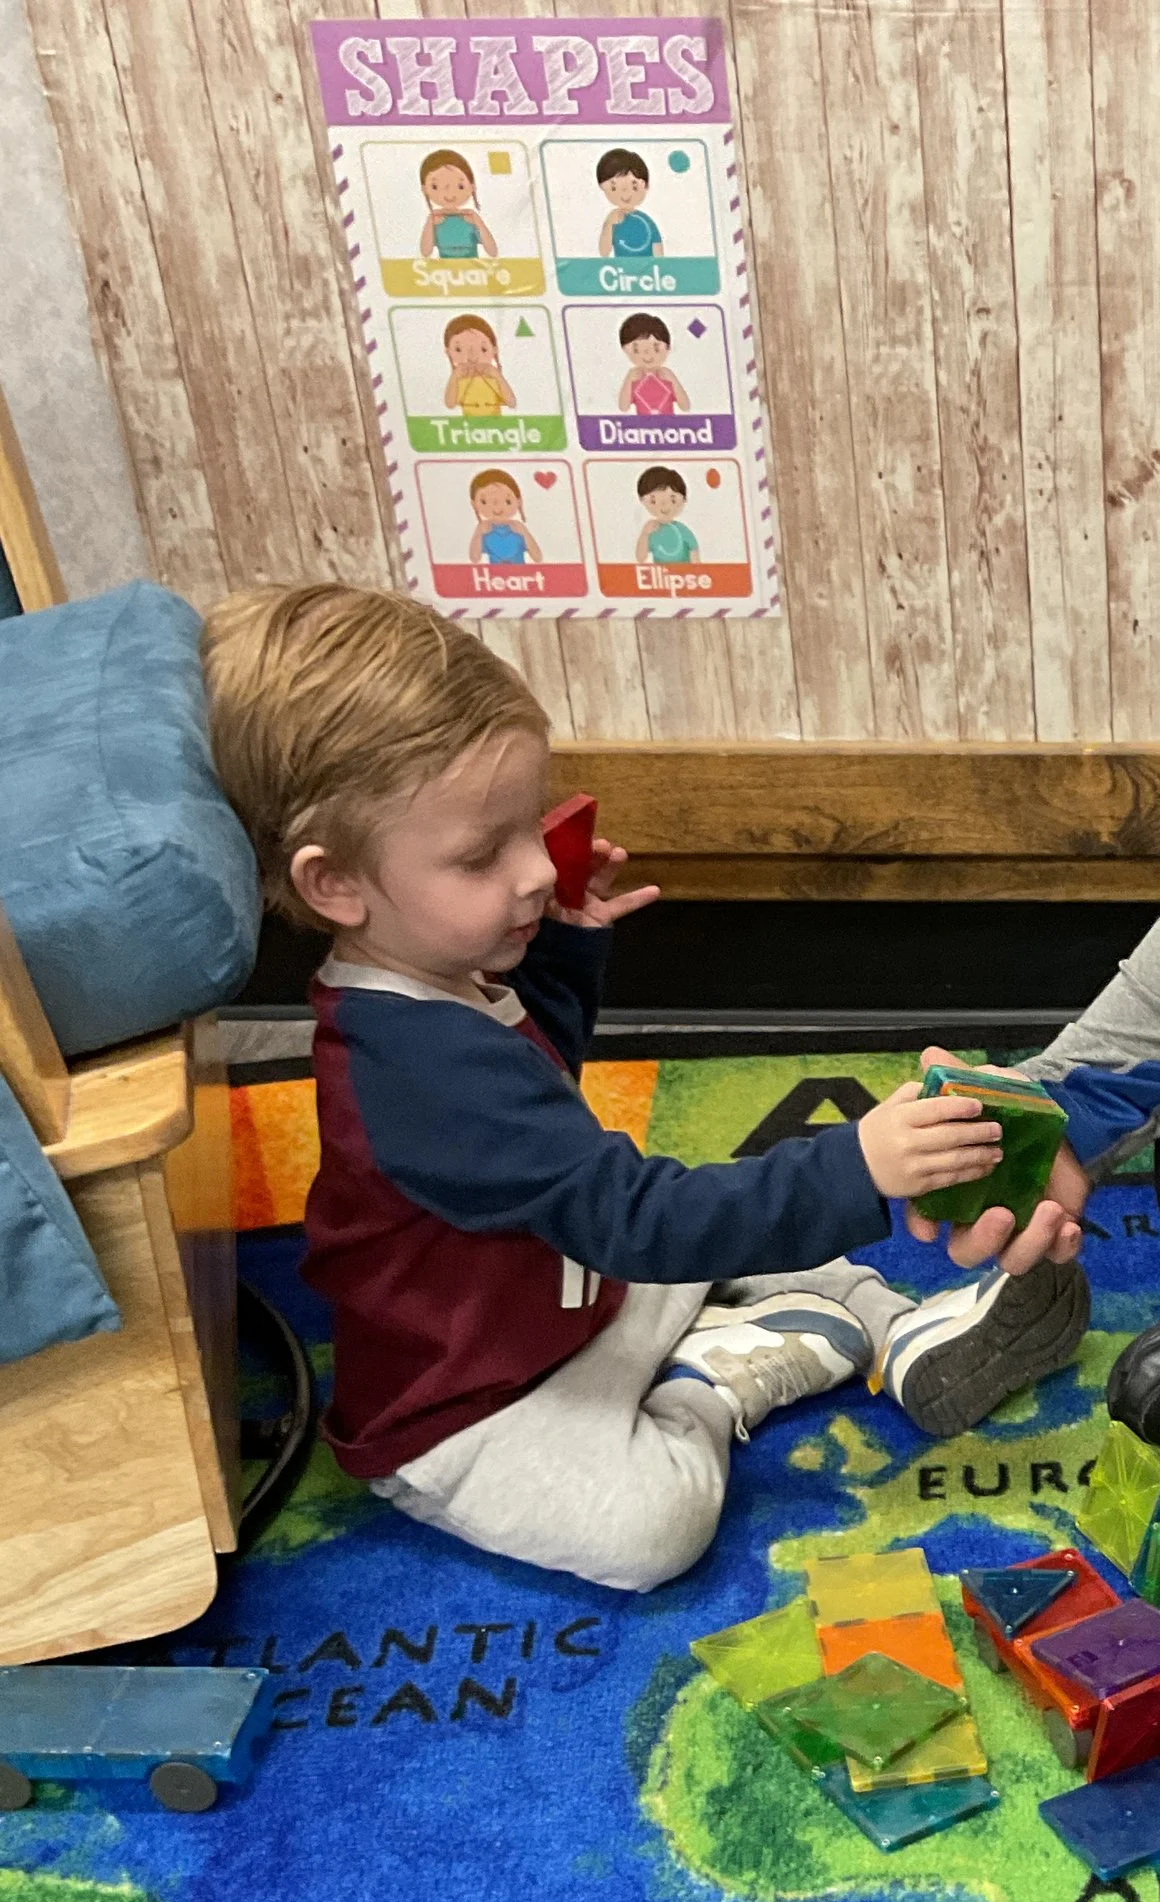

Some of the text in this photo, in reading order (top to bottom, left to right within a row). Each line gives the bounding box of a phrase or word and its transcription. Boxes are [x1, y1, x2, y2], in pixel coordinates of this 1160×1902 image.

[338, 34, 716, 117] SHAPES
[412, 262, 512, 289] Square
[599, 266, 677, 293] Circle
[430, 419, 542, 452] Triangle
[600, 419, 714, 446] Diamond
[472, 569, 546, 592] Heart
[635, 568, 713, 598] Ellipse
[165, 1616, 603, 1674] TLANTIC
[271, 1676, 518, 1731] CEAN
